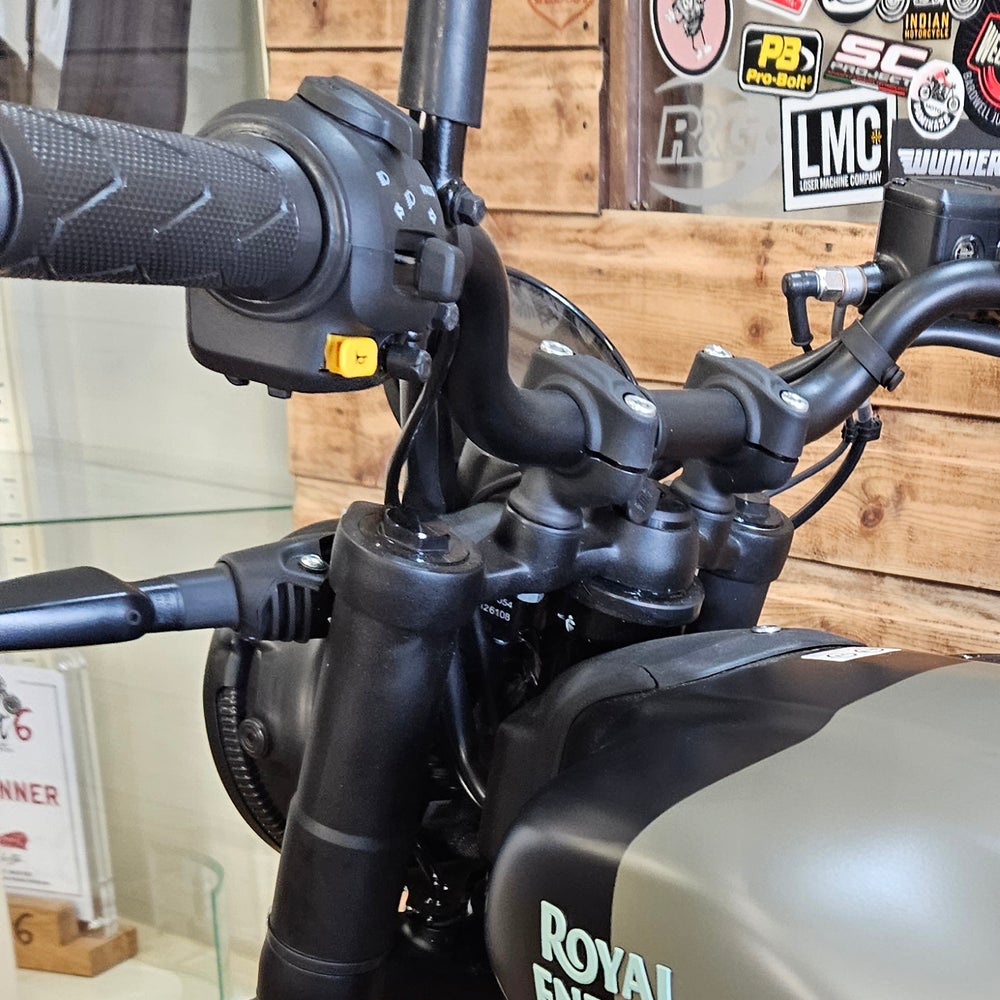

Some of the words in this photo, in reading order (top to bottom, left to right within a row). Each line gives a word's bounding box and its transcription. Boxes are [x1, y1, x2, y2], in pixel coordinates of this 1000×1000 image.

[905, 12, 949, 29] INDIAN
[905, 28, 949, 40] MOTORCYCLE
[758, 34, 802, 71] PB
[834, 33, 928, 79] SC
[963, 72, 992, 120] BARDWELL
[656, 104, 758, 165] R&G
[798, 104, 882, 179] LMC
[800, 179, 820, 192] LOSER
[820, 174, 849, 190] MACHINE
[849, 170, 882, 187] COMPANY
